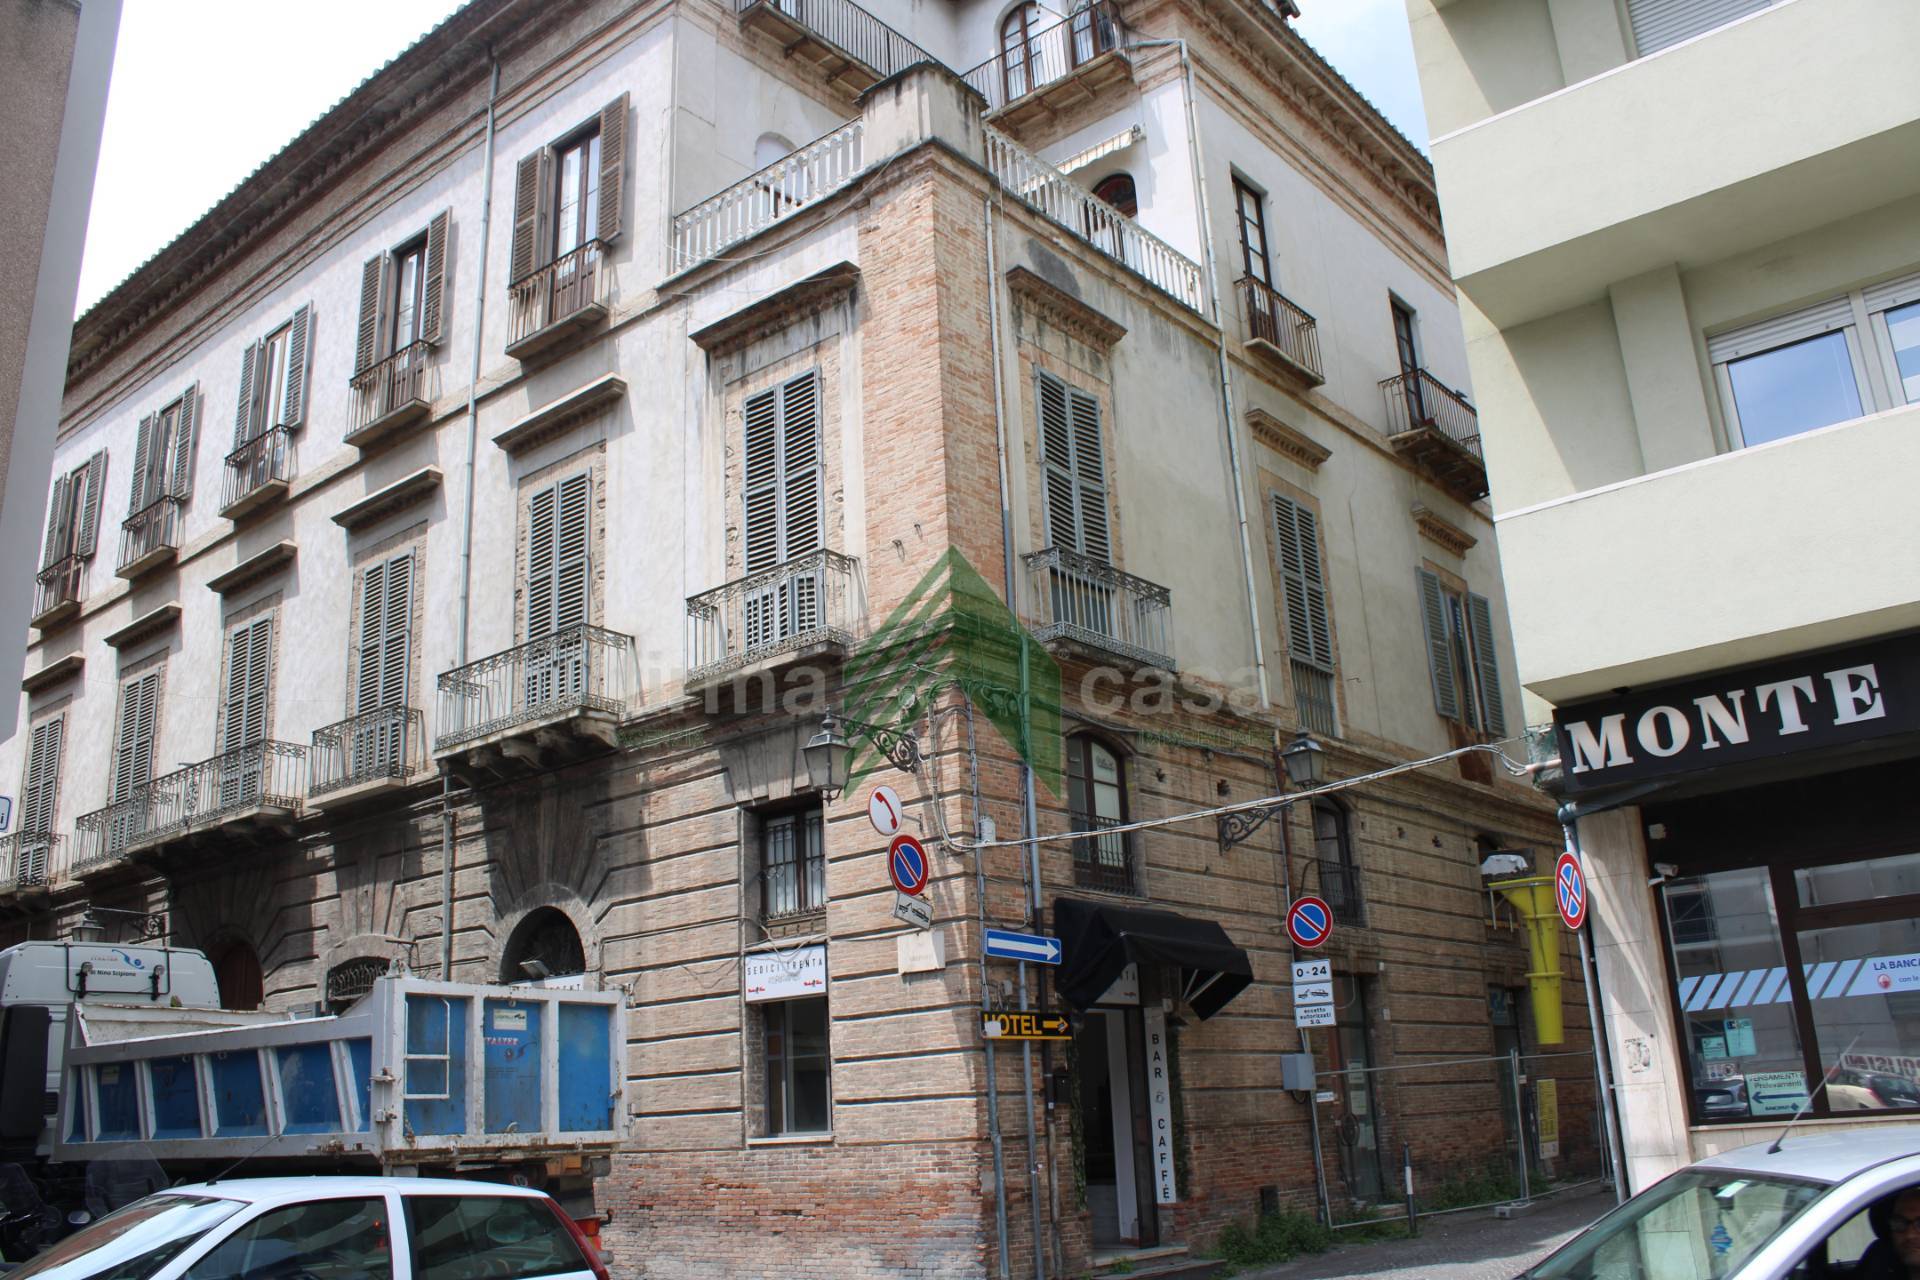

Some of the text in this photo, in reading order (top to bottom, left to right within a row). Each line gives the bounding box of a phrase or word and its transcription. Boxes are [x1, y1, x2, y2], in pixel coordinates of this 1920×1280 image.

[1564, 663, 1887, 774] MONTE
[747, 958, 823, 976] SEDICI TRENTA
[1873, 958, 1920, 971] LA BANC
[1152, 1033, 1163, 1079] BAR
